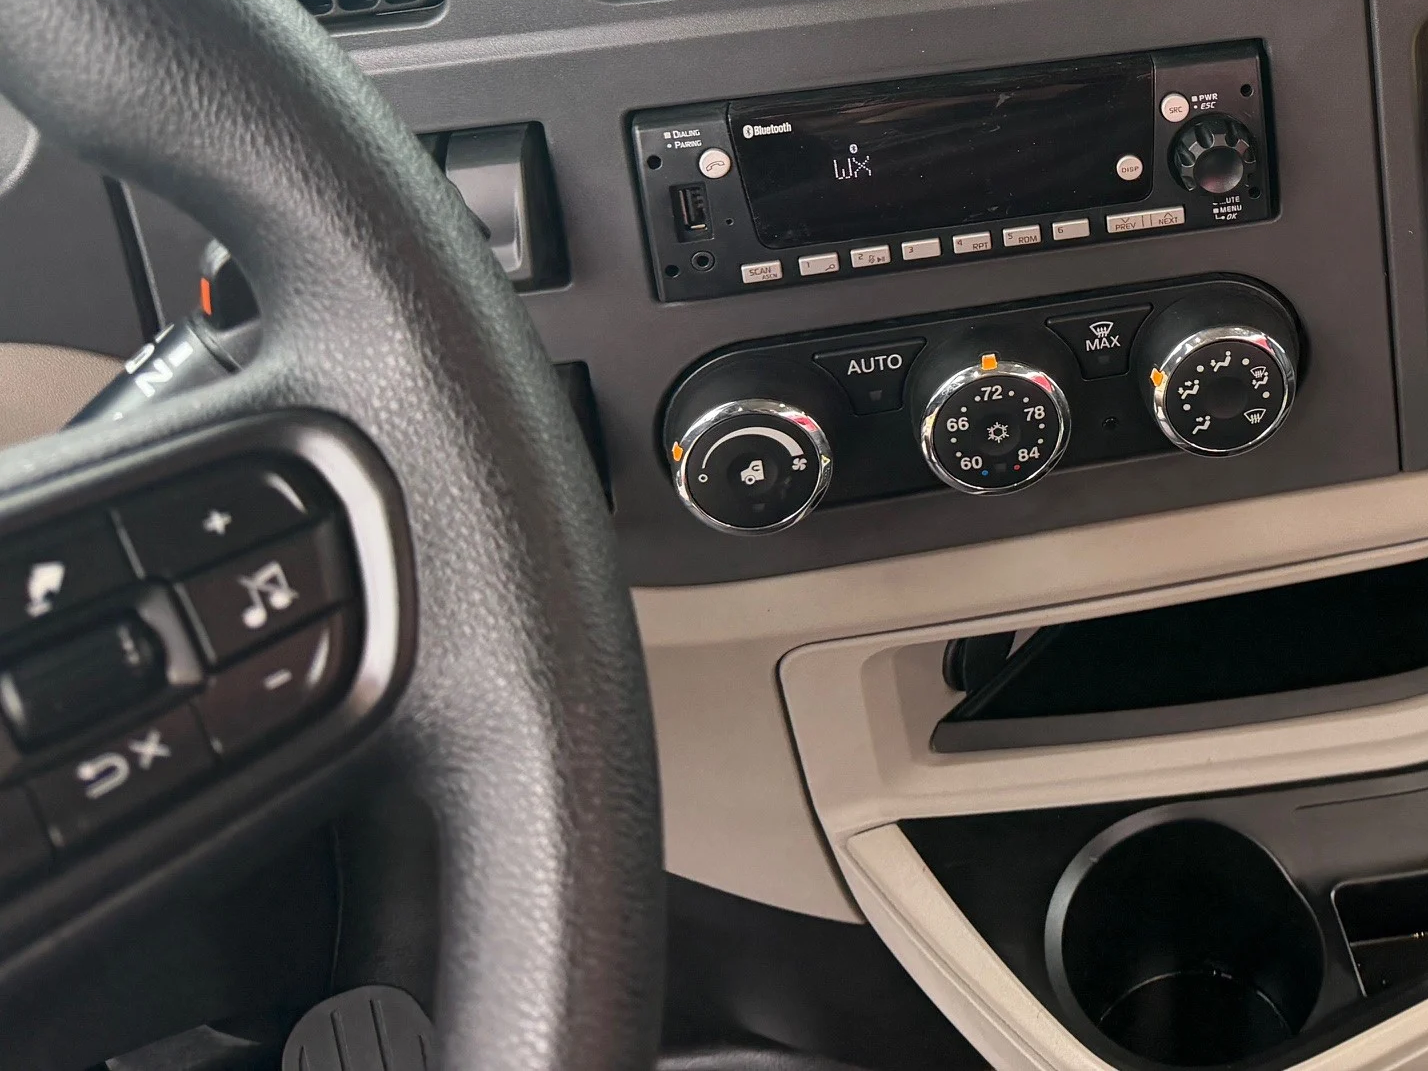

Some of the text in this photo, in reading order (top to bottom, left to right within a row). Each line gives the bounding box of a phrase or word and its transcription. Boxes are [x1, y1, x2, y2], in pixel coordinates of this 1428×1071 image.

[1199, 93, 1218, 102] PWR
[1169, 106, 1183, 114] SRC
[1200, 101, 1216, 110] ESC
[753, 122, 792, 136] Bluetooth
[833, 155, 872, 180] WX
[1121, 165, 1140, 173] DISP
[1219, 195, 1241, 205] UTE
[1219, 204, 1242, 214] MENU
[1158, 217, 1179, 225] NEXT
[1226, 212, 1238, 221] OK
[1115, 222, 1137, 230] PREV
[1018, 235, 1038, 244] RDM
[972, 242, 989, 250] RPT
[749, 266, 771, 277] SCAN
[1085, 335, 1121, 352] MAX
[847, 353, 903, 376] AUTO
[980, 385, 1003, 401] 72
[1024, 405, 1046, 422] 78
[946, 417, 969, 432] 66
[1018, 446, 1040, 462] 84
[960, 455, 983, 471] 60
